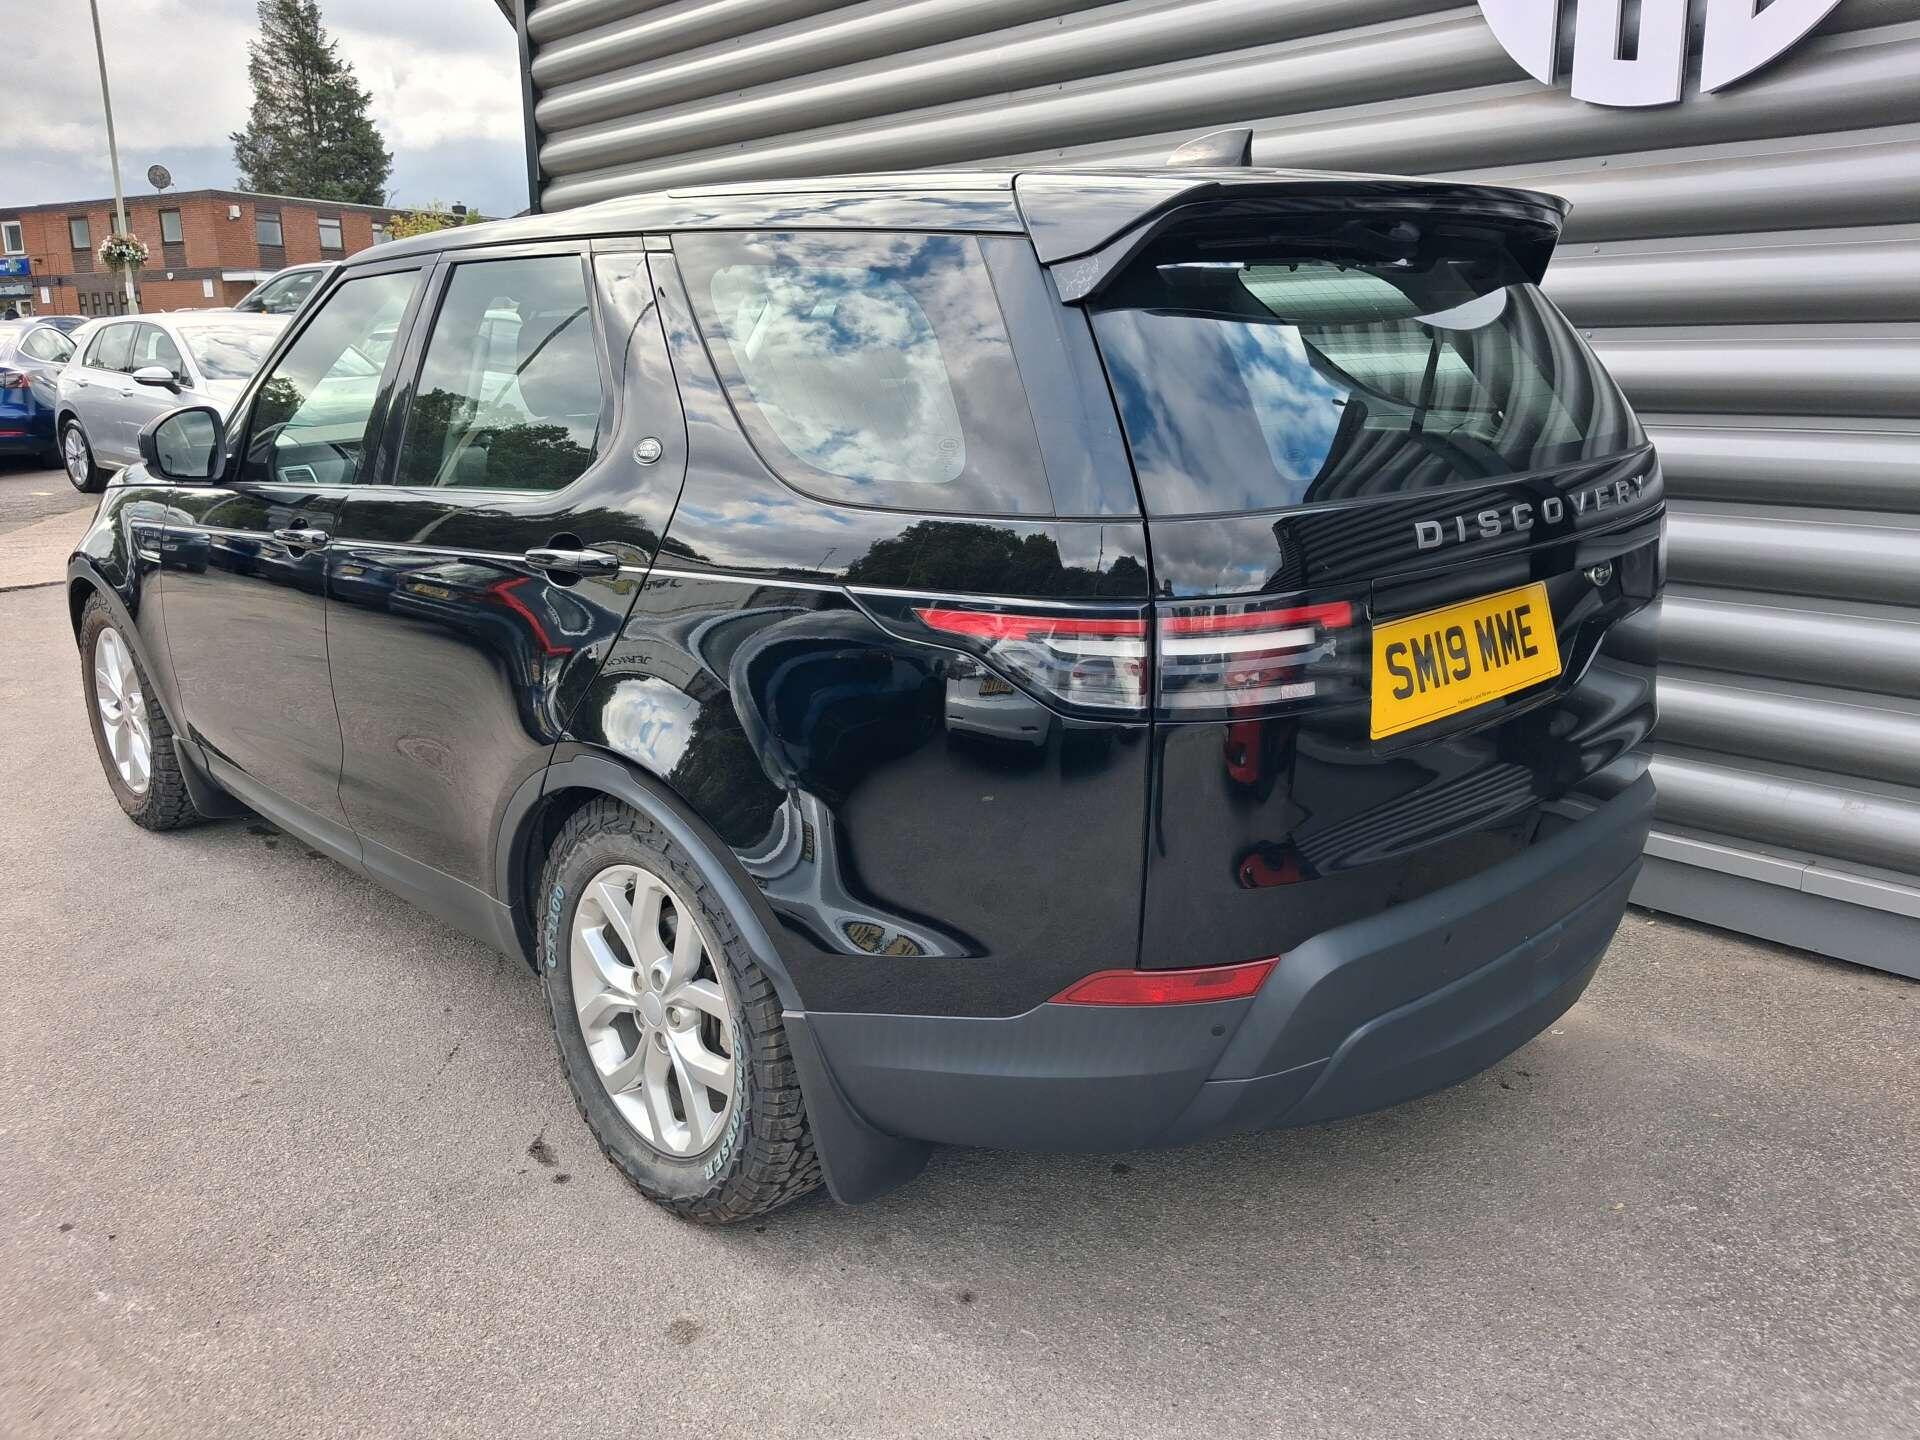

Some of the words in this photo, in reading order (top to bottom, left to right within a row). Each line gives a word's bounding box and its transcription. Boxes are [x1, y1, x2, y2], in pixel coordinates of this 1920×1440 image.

[1414, 473, 1646, 550] DISCOVERY
[1384, 625, 1472, 701] SM19
[1474, 604, 1539, 673] MME
